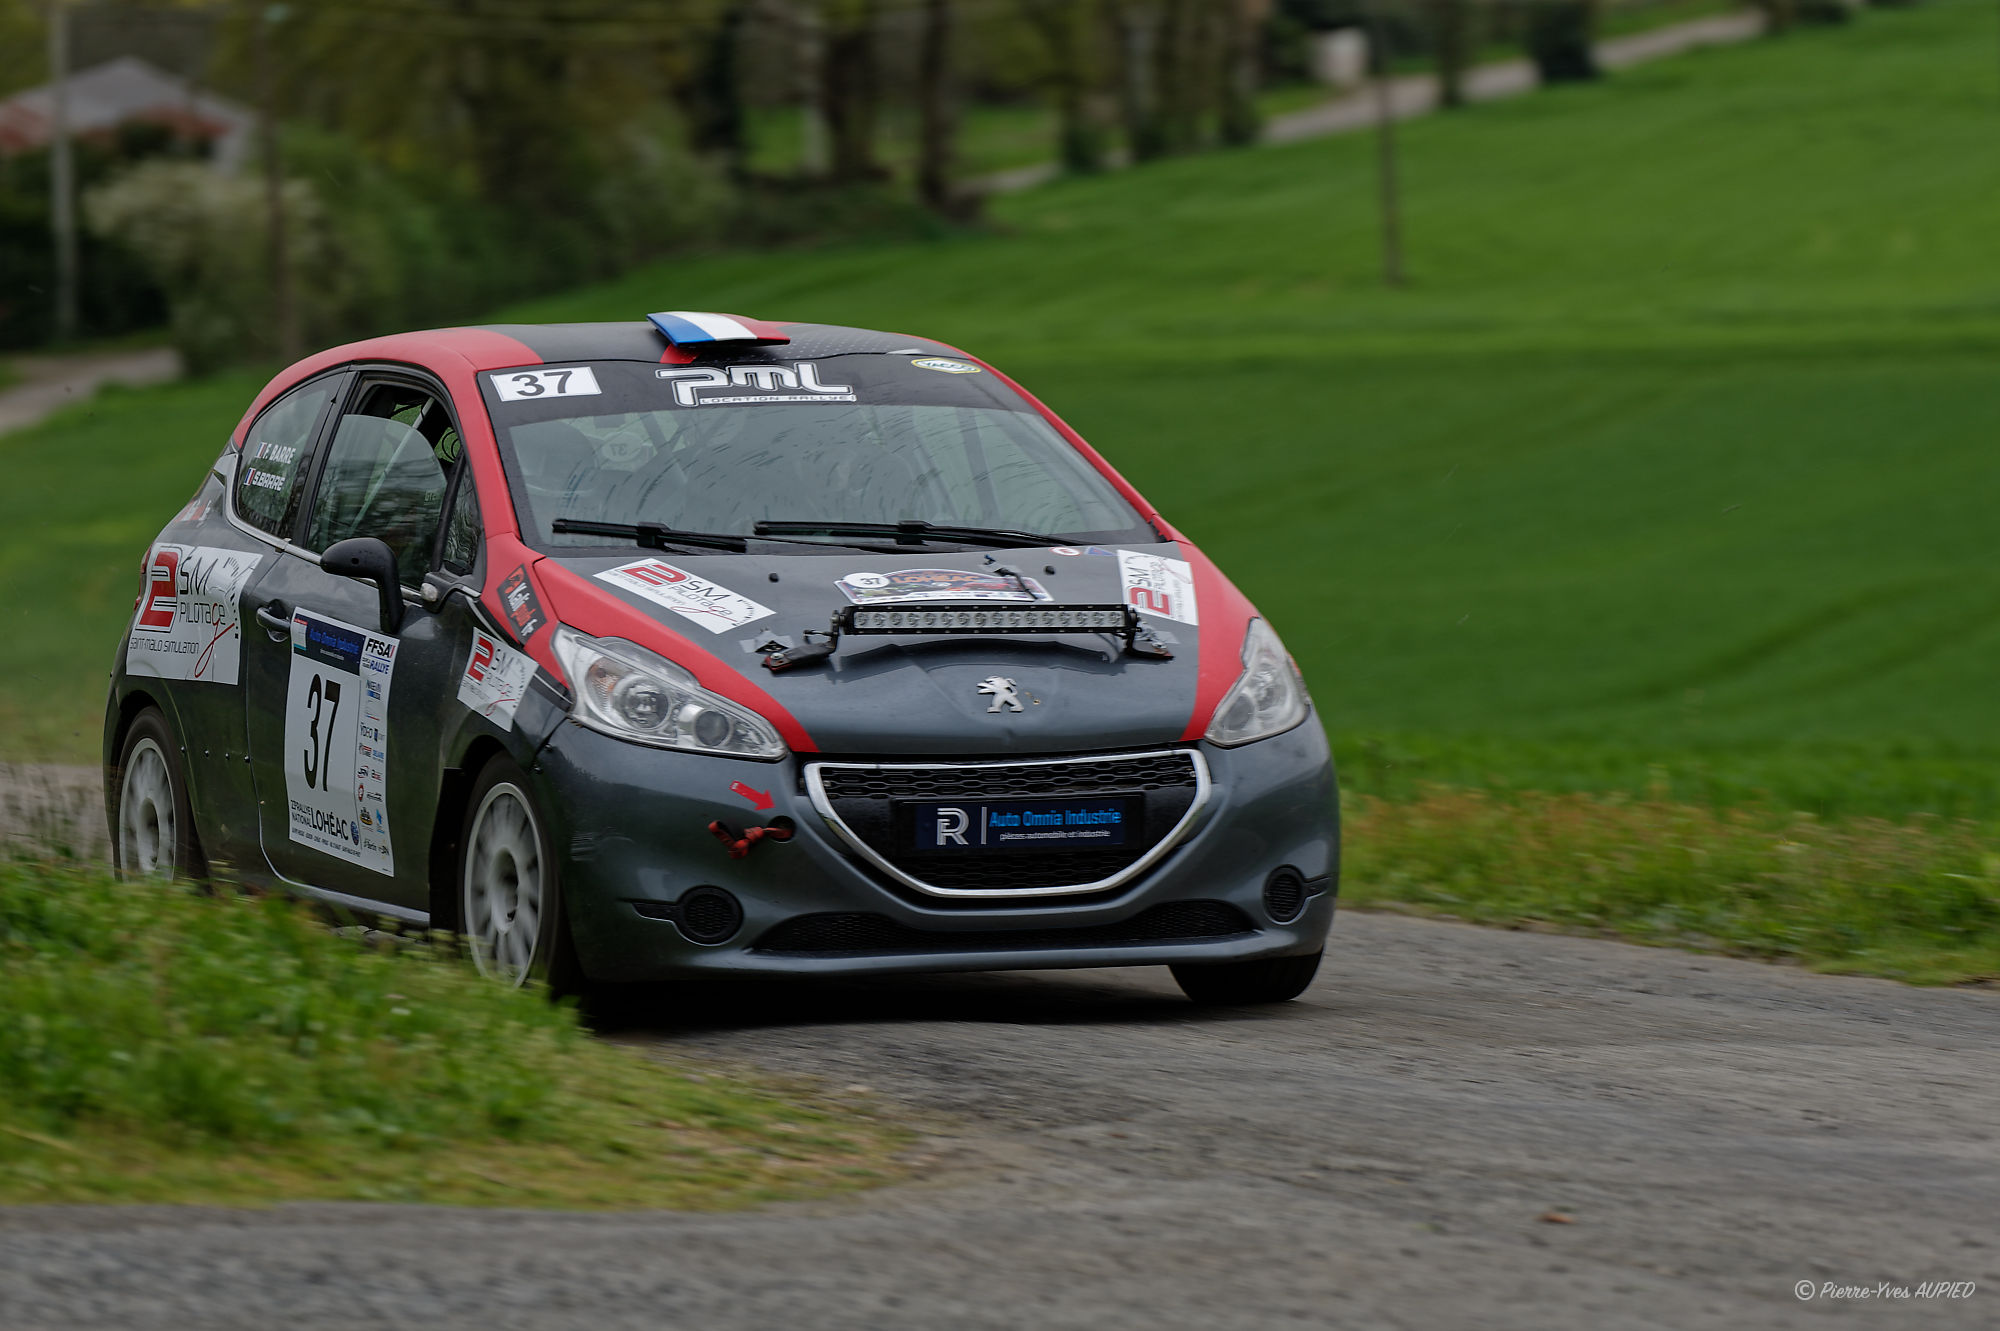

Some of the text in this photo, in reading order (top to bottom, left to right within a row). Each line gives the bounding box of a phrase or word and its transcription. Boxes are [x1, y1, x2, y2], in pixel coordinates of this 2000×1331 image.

[511, 370, 573, 397] 37
[700, 396, 780, 404] LOCATION
[860, 576, 880, 585] 37
[365, 638, 392, 658] FFSA
[304, 673, 342, 792] 37
[310, 807, 349, 841] LOHÉAC
[989, 808, 1122, 827] Auto Omnia Industrie
